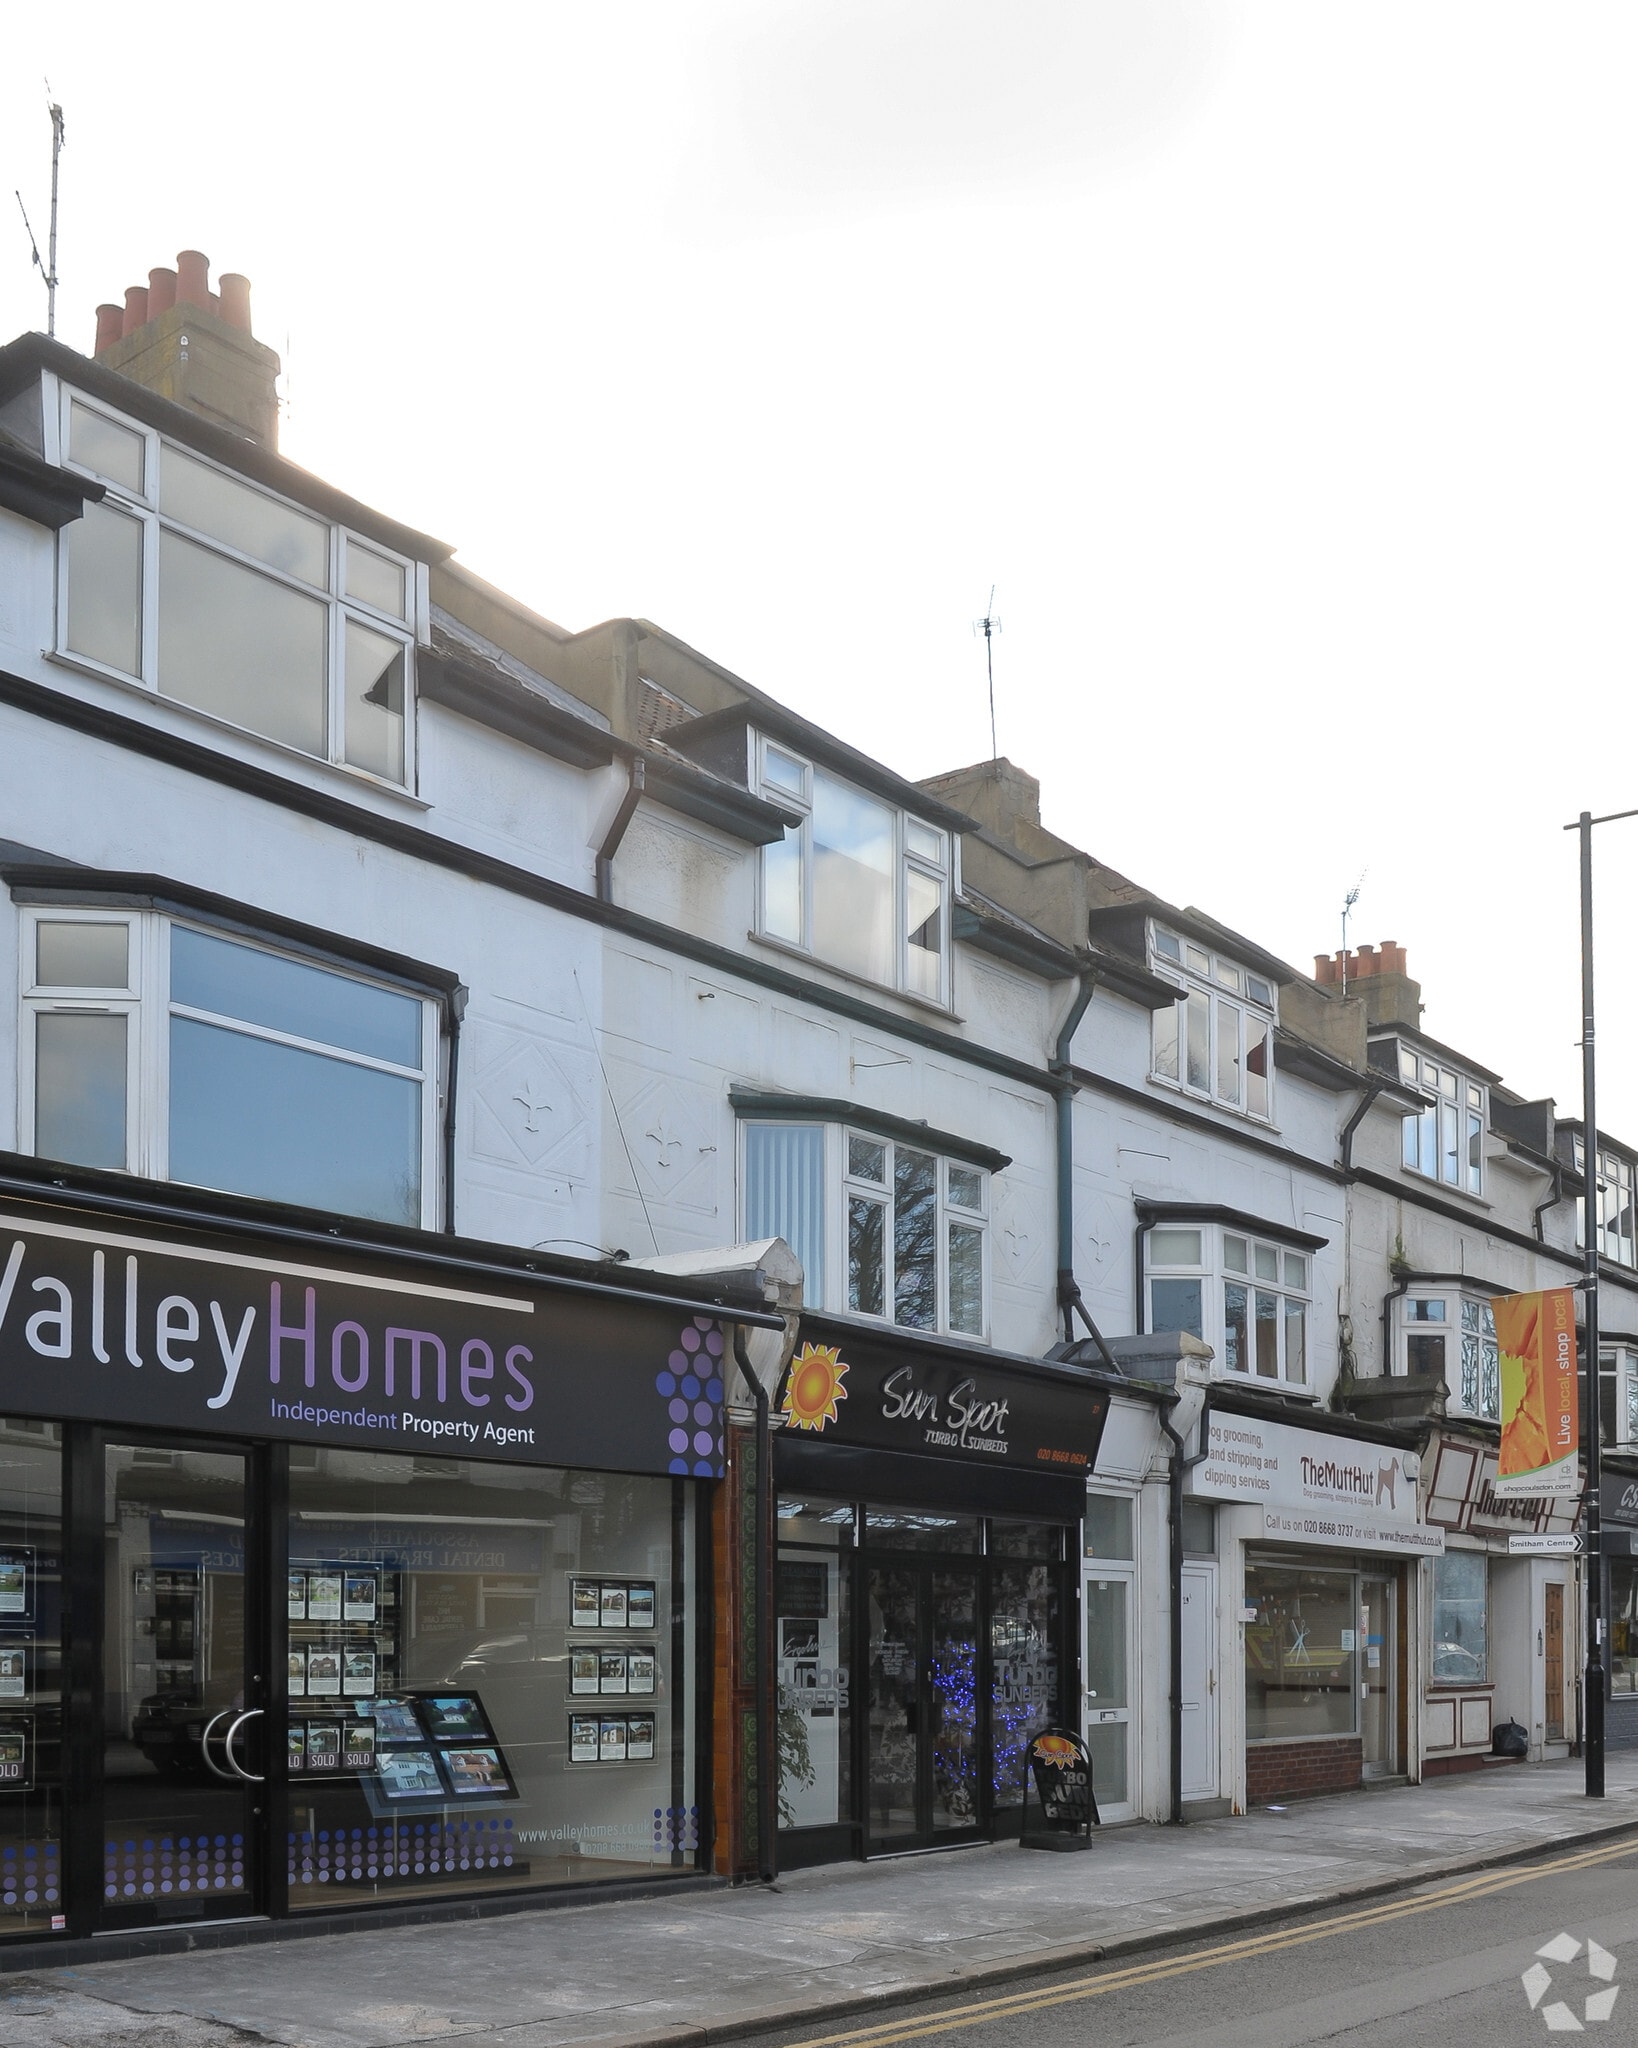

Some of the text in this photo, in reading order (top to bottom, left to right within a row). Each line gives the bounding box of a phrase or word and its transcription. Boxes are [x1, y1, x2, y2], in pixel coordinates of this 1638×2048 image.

[1551, 1294, 1567, 1331] local
[1555, 1333, 1571, 1369] shop
[882, 1366, 1009, 1448] Sun Spot
[271, 1398, 535, 1445] Independent Property Agent
[1557, 1415, 1571, 1445] Live
[924, 1429, 1009, 1454] TURBO SUNBEDS
[1210, 1426, 1264, 1449] og grooming,
[1209, 1448, 1278, 1471] and stripping and
[1204, 1467, 1271, 1490] clipping services
[1300, 1456, 1374, 1495] TheMuttHut
[1503, 1483, 1571, 1493] shopcoulsdon.com
[1265, 1514, 1280, 1528] Call
[1282, 1518, 1291, 1530] us
[1293, 1521, 1303, 1532] on
[1303, 1520, 1317, 1533] 020
[1319, 1522, 1336, 1535] 8668
[1337, 1525, 1353, 1537] 3737
[1354, 1529, 1362, 1539] or
[1363, 1527, 1377, 1540] visit
[1510, 1539, 1574, 1548] Smitham Centre
[778, 1660, 849, 1690] urbo
[993, 1659, 1058, 1686] Turbo
[993, 1684, 1057, 1703] SUNBEDS
[0, 1764, 19, 1778] OLD
[311, 1754, 335, 1767] SOLD
[347, 1753, 370, 1766] SOLD
[518, 1819, 650, 1843] www.valleyhomes.co.uk
[585, 1843, 608, 1855] 0208
